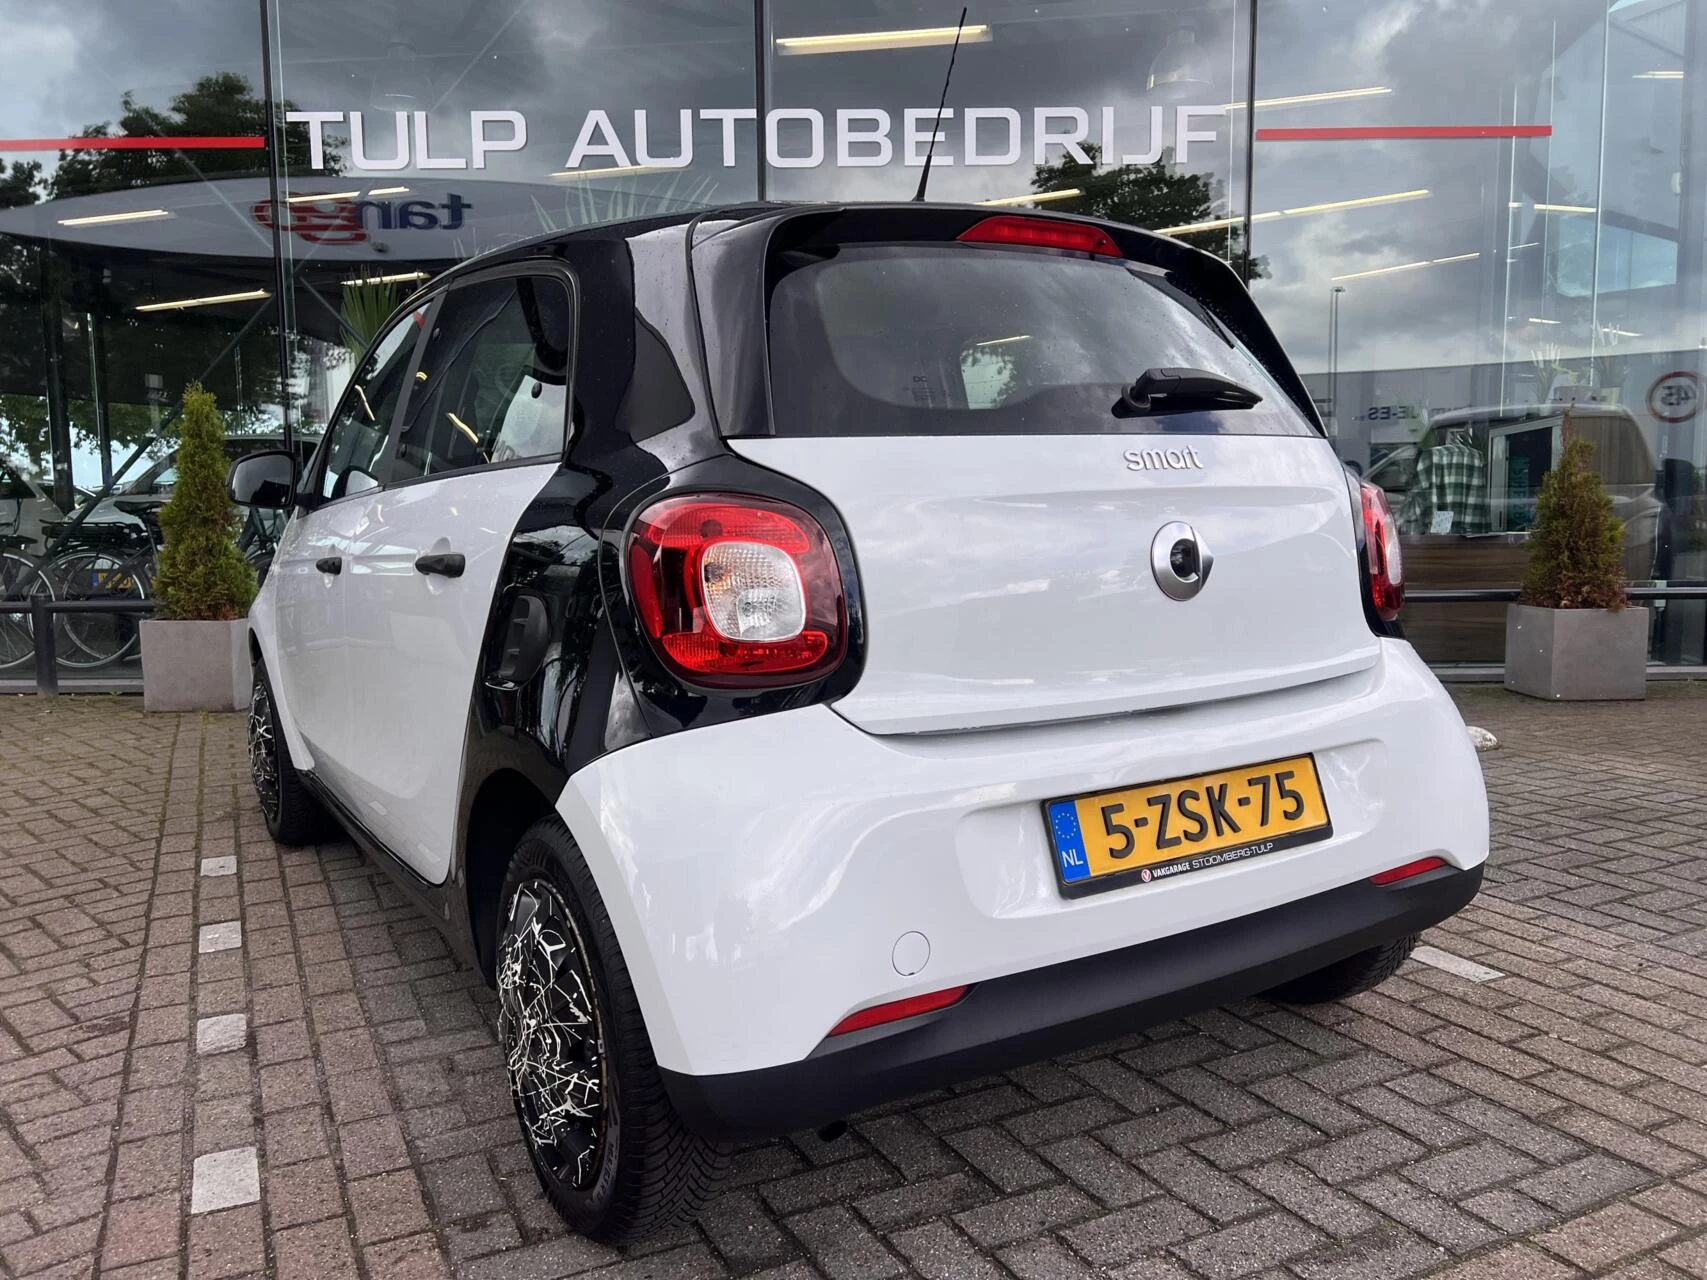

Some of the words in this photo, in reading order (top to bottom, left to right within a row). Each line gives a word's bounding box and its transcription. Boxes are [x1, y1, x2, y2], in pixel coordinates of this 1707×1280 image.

[286, 110, 528, 170] TULP
[565, 104, 1227, 170] AUTOBEDRIJF
[1123, 445, 1204, 472] smart
[1062, 848, 1084, 868] NL
[1100, 770, 1305, 860] 5-ZSK-75
[1152, 862, 1191, 878] VAKGARAGE
[1192, 842, 1274, 869] STOOMBERG-TULP
